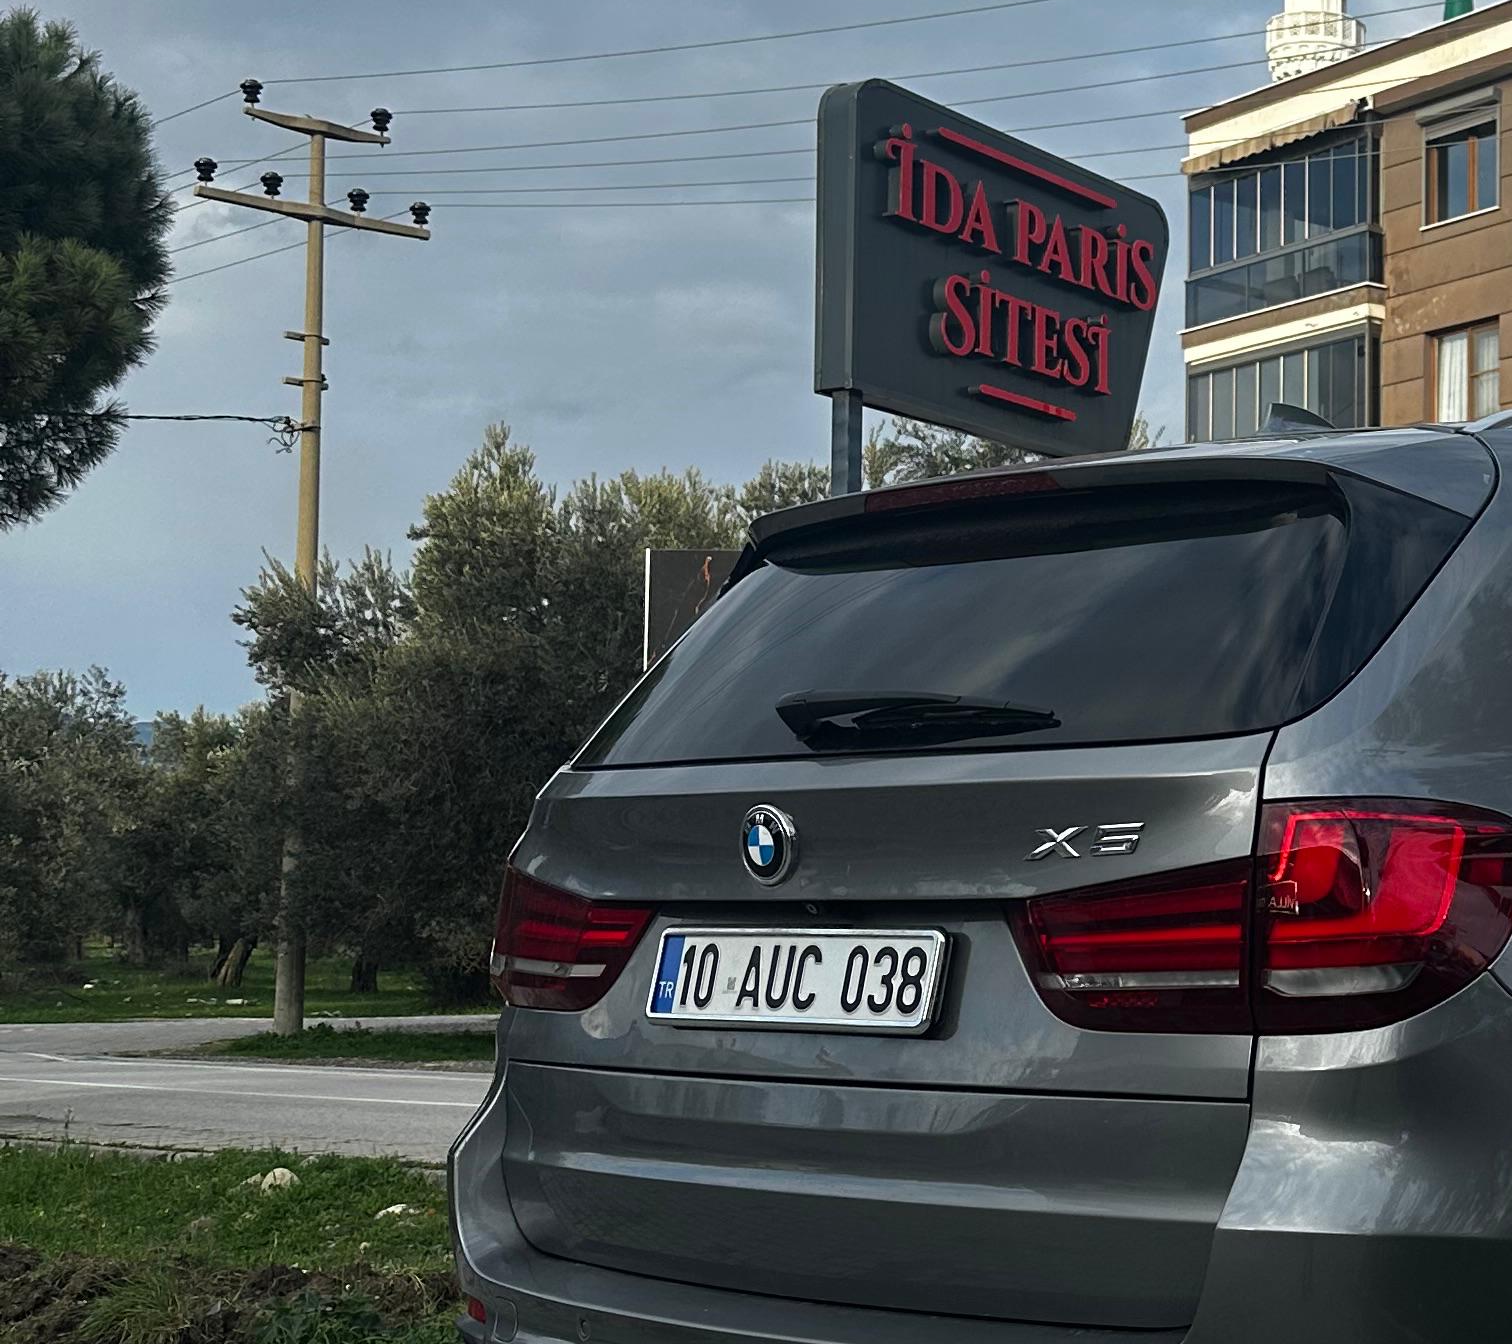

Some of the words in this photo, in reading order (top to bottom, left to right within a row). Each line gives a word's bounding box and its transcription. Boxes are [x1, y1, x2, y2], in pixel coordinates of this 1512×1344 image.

[884, 122, 1002, 254] İDA
[1008, 198, 1157, 312] PARİS
[940, 269, 1112, 396] SİTESİ
[1023, 822, 1145, 861] X5
[659, 980, 674, 999] TR
[679, 943, 720, 1009] 10
[735, 944, 823, 1011] AUC
[840, 944, 928, 1014] 038
